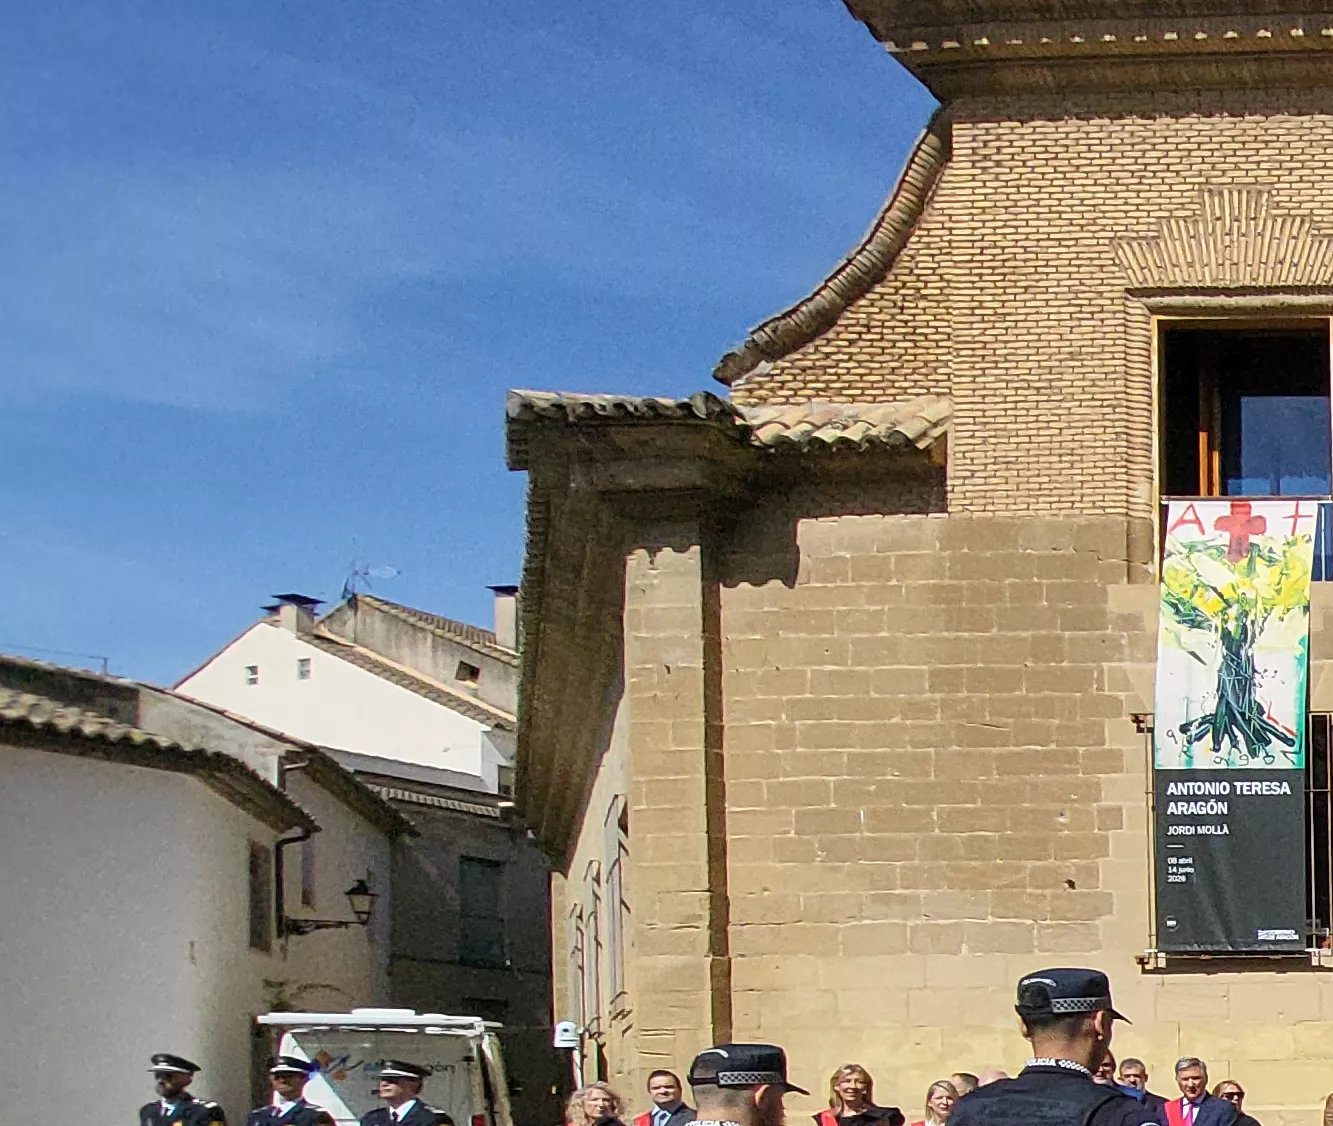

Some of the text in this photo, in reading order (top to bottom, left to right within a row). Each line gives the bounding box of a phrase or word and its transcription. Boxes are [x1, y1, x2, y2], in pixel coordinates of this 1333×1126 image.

[1166, 781, 1291, 796] ANTONIO TERESA
[1166, 799, 1228, 815] ARAGÓN
[1166, 825, 1195, 836] JORDI
